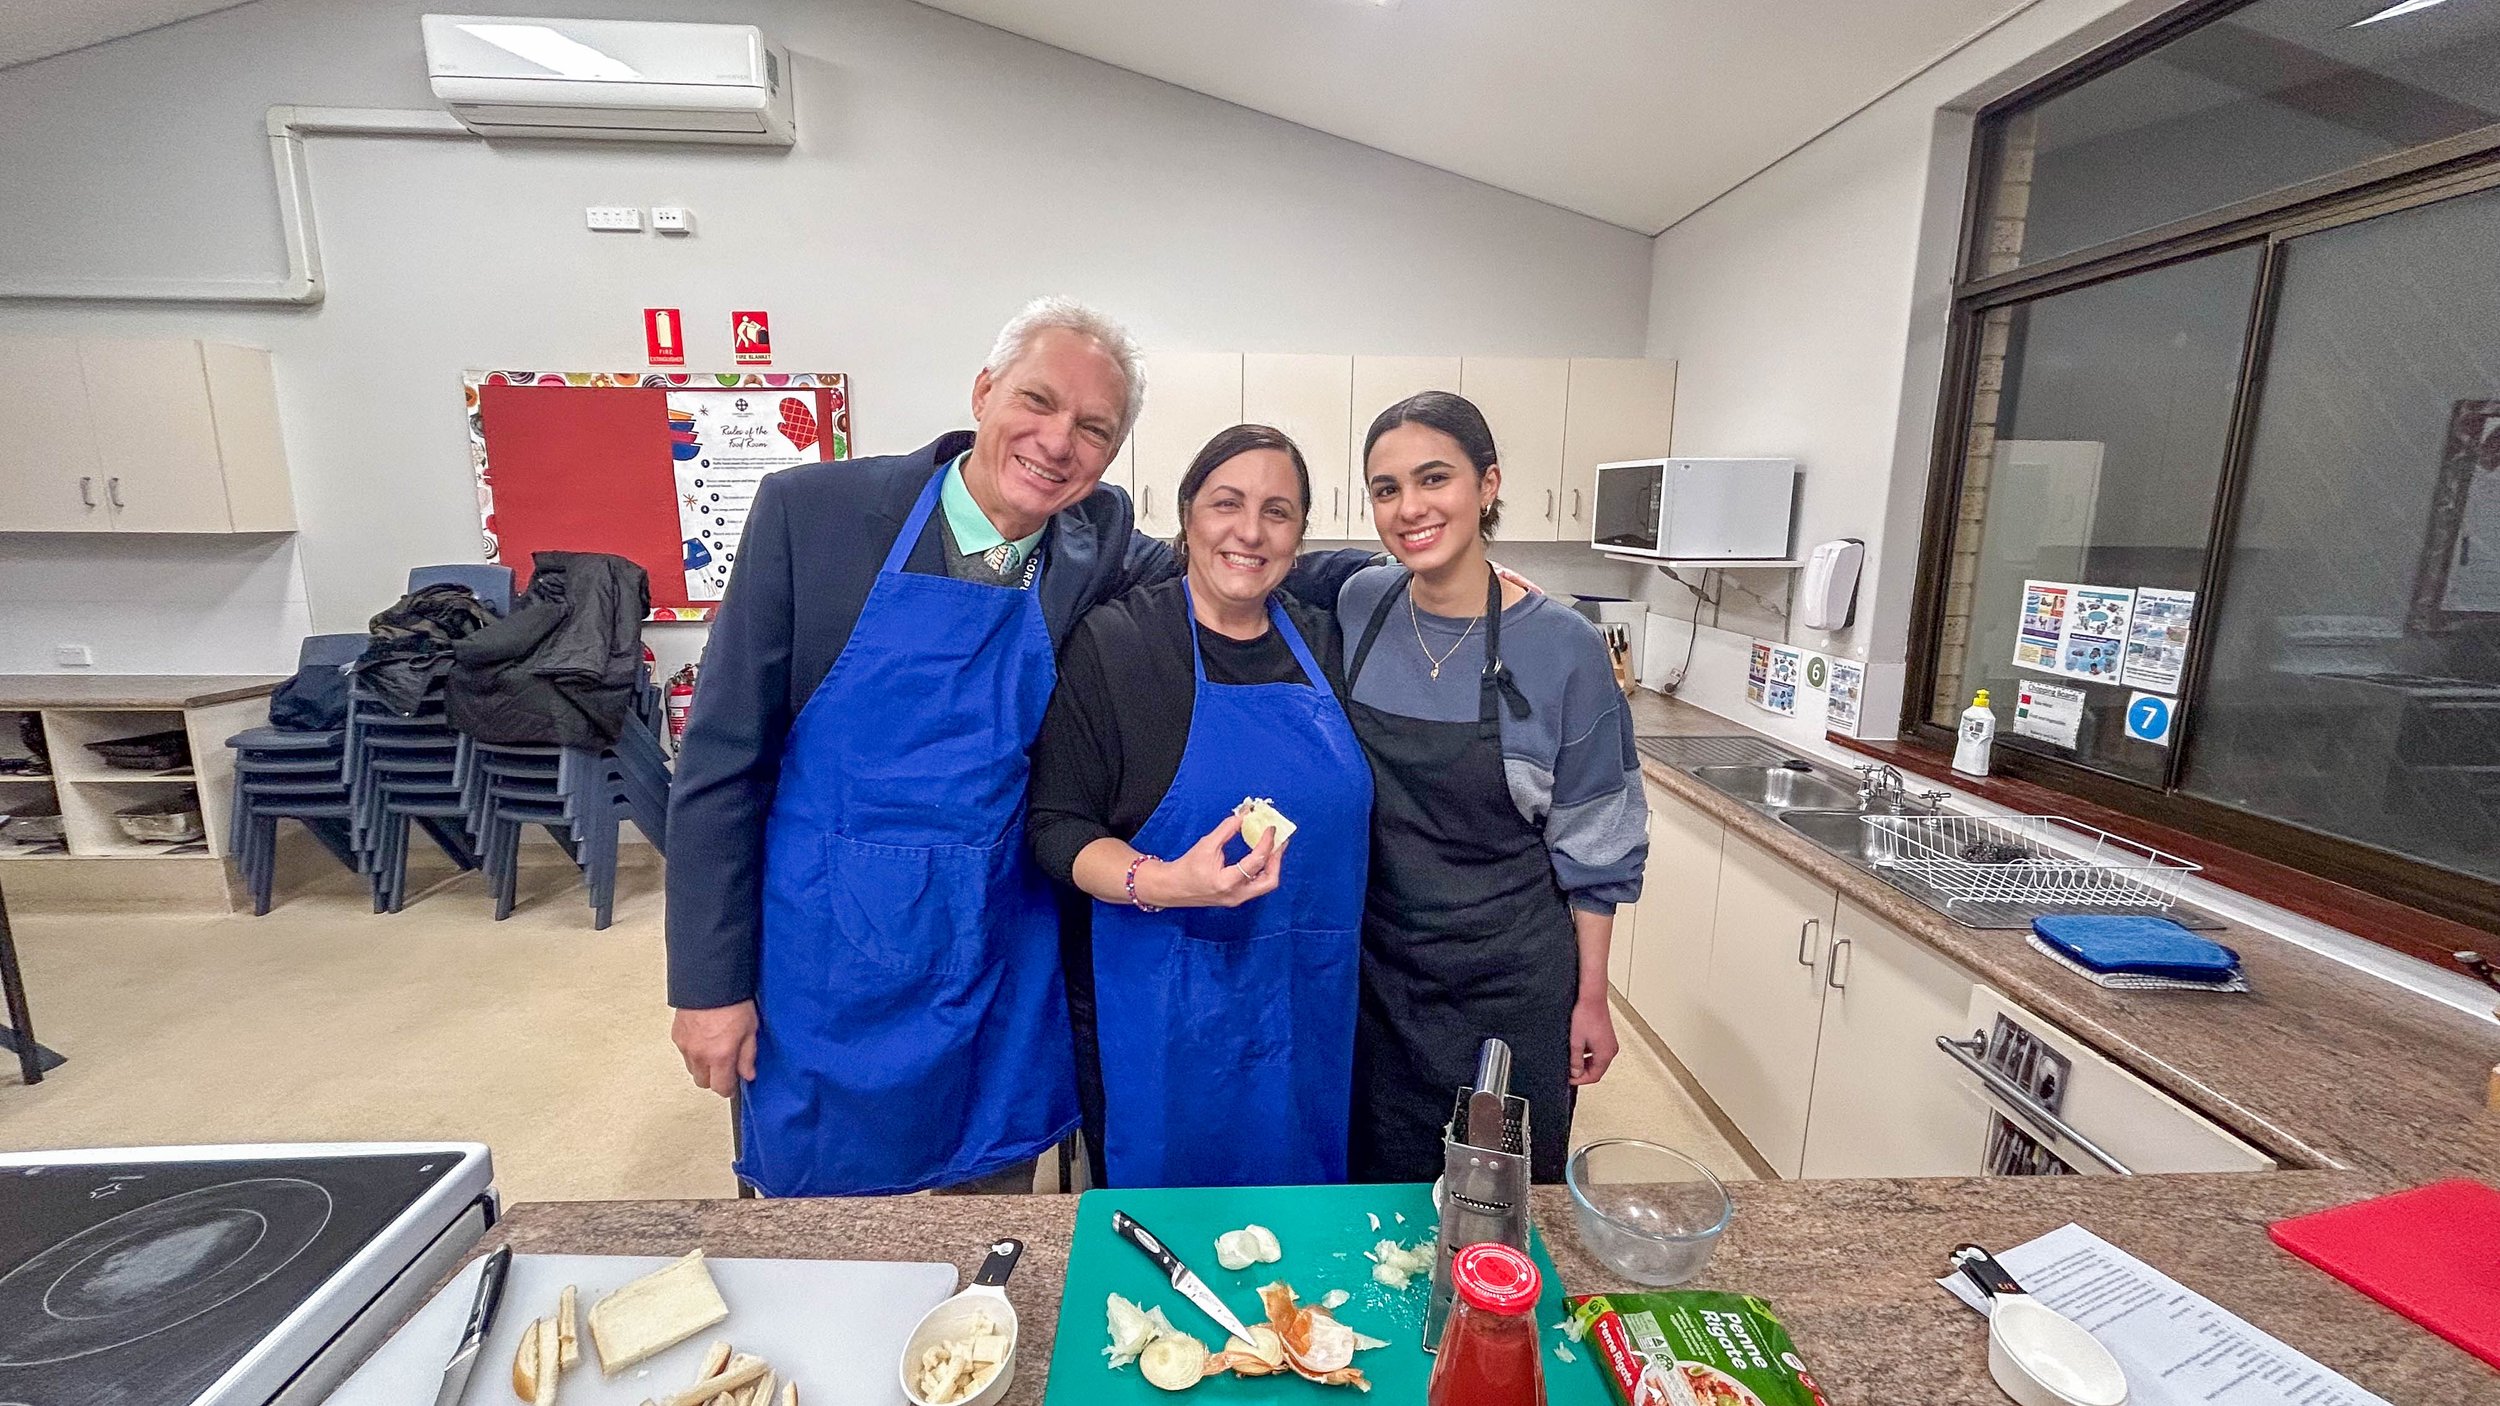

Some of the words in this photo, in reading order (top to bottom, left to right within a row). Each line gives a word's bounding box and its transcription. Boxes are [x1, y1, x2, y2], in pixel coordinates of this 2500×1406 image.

[720, 424, 743, 436] Rules
[744, 427, 755, 437] of
[755, 425, 768, 436] the
[728, 436, 745, 449] Food
[745, 438, 768, 448] Room
[1811, 663, 1821, 681] 6
[2027, 683, 2056, 698] Chopping
[2141, 706, 2158, 730] 7
[1699, 1309, 1748, 1370] Rigate
[1720, 1312, 1769, 1369] Penne
[1598, 1320, 1617, 1353] Penne
[1612, 1350, 1633, 1387] Rigate
